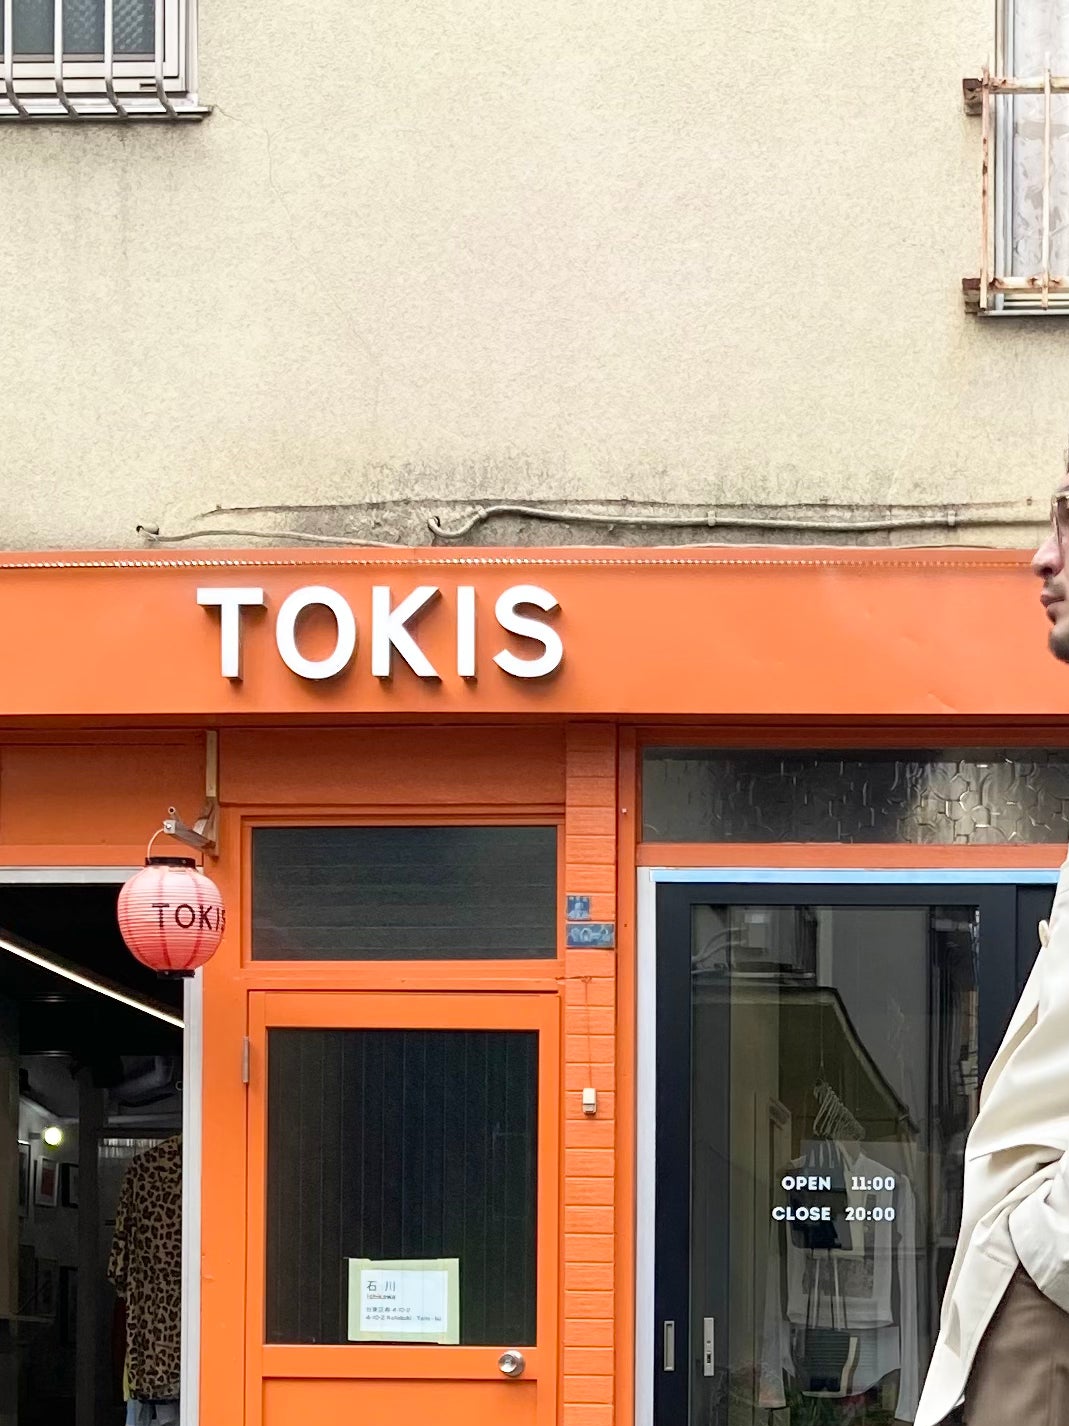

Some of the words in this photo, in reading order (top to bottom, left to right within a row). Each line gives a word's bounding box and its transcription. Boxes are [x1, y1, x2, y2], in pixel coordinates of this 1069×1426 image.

[196, 584, 564, 681] TOKIS
[781, 1176, 831, 1191] OPEN
[851, 1176, 895, 1191] 11:00
[771, 1206, 831, 1221] CLOSE
[845, 1206, 895, 1221] 20:00
